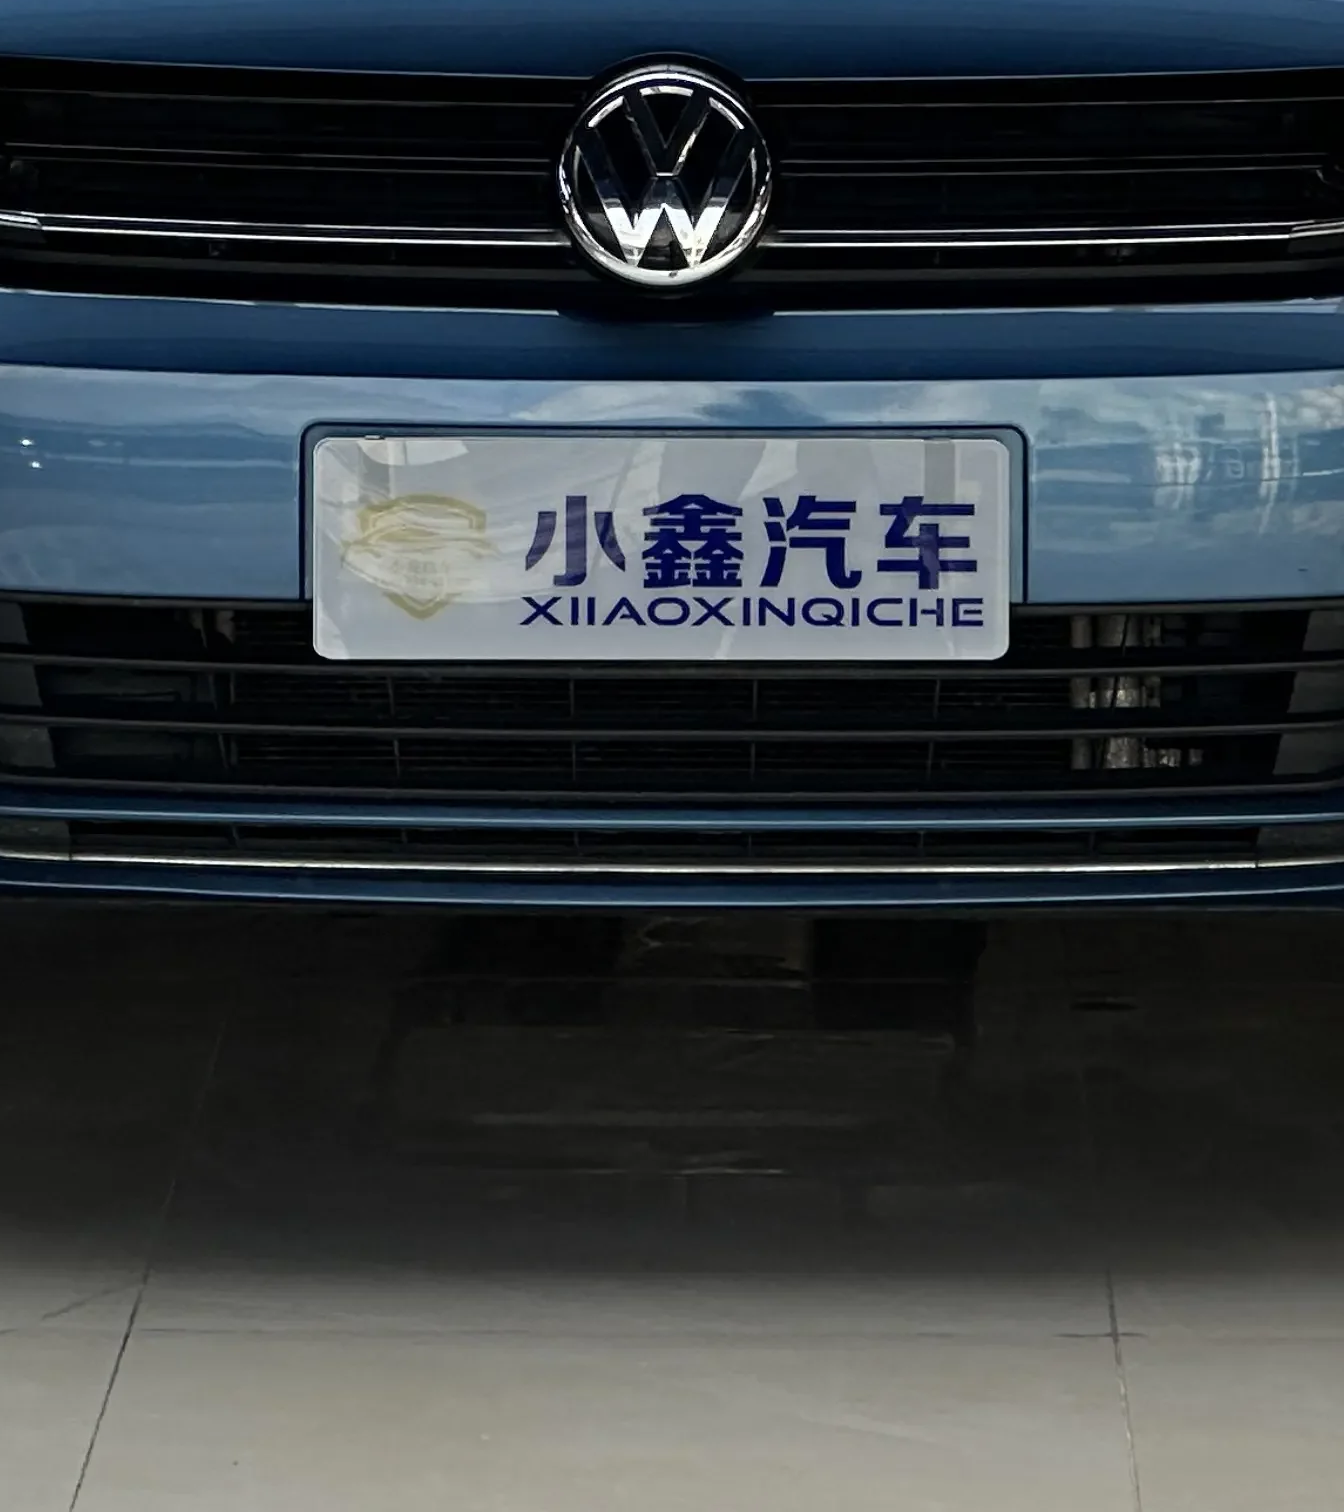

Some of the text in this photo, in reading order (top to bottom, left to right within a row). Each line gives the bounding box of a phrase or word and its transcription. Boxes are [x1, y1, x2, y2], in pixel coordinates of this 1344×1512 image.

[524, 493, 978, 590] 小鑫汽车
[519, 595, 984, 628] XIIAOXINQICHE
